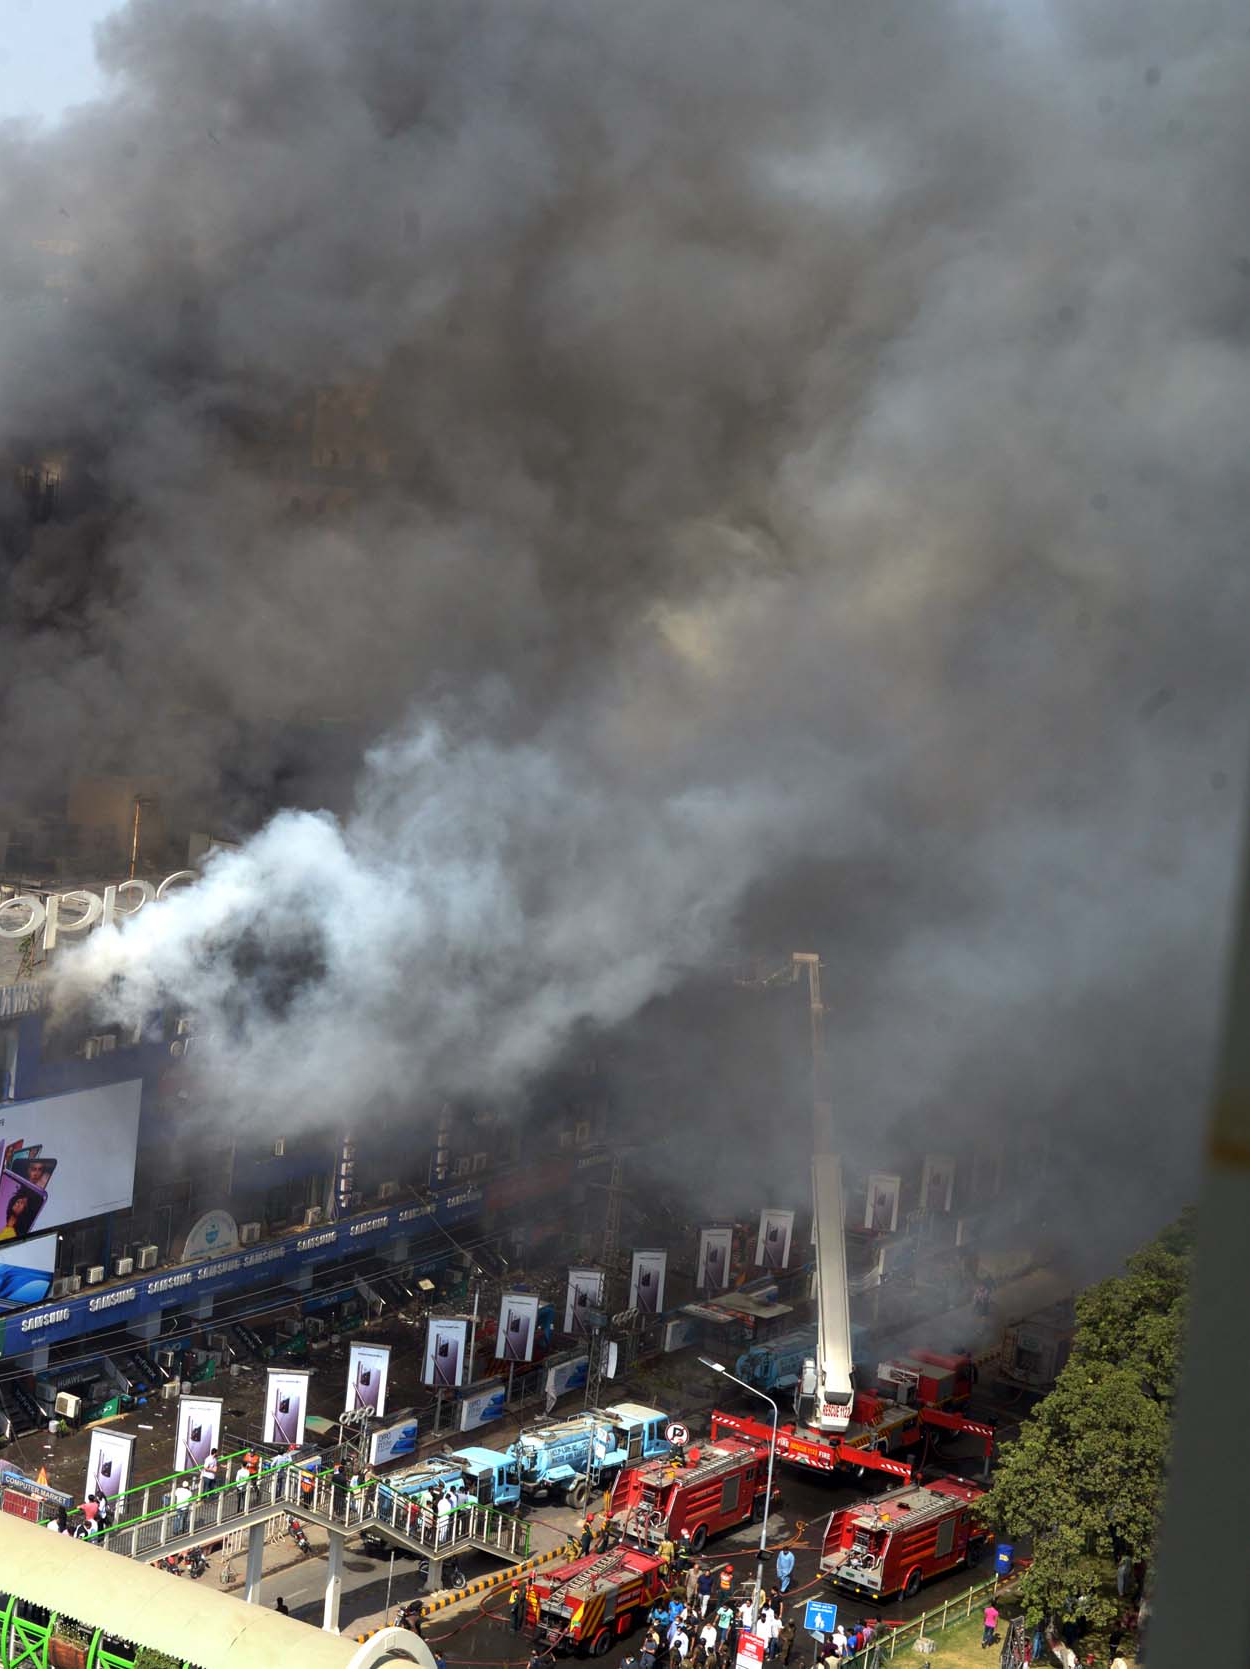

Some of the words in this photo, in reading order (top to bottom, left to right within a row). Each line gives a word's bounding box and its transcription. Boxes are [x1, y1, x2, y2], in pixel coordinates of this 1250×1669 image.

[296, 1231, 337, 1251] SAMSUNG
[148, 1272, 192, 1295] SAMSUNG
[89, 1287, 136, 1312] SAMSUNG
[21, 1307, 70, 1332] SAMSUNG
[339, 1406, 375, 1426] oppo
[823, 1404, 839, 1418] RESCUE
[840, 1406, 851, 1418] 1122
[818, 1451, 830, 1460] FIRE
[5, 1475, 40, 1495] COMPUTER
[41, 1488, 67, 1505] MARKET
